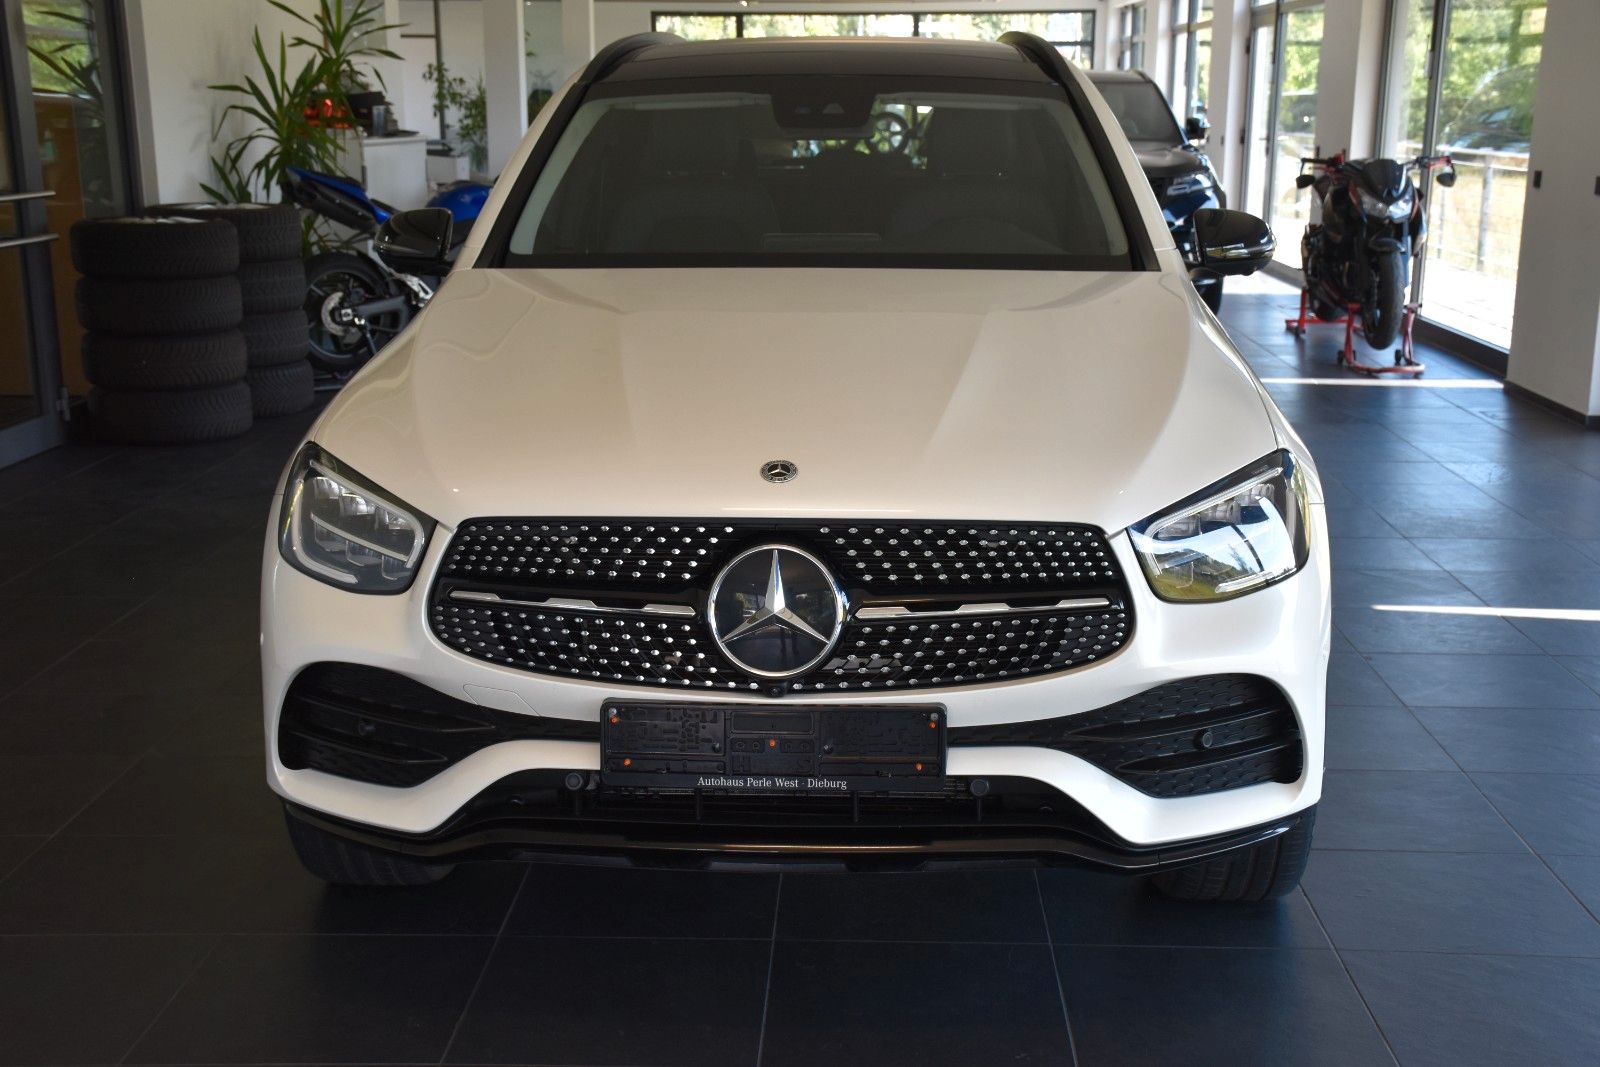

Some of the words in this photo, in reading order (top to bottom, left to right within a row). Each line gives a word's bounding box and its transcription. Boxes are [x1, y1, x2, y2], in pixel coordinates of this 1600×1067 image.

[697, 777, 744, 787] Autohaus
[747, 777, 772, 787] Perle
[775, 778, 799, 788] West
[807, 778, 847, 790] Dieburg
